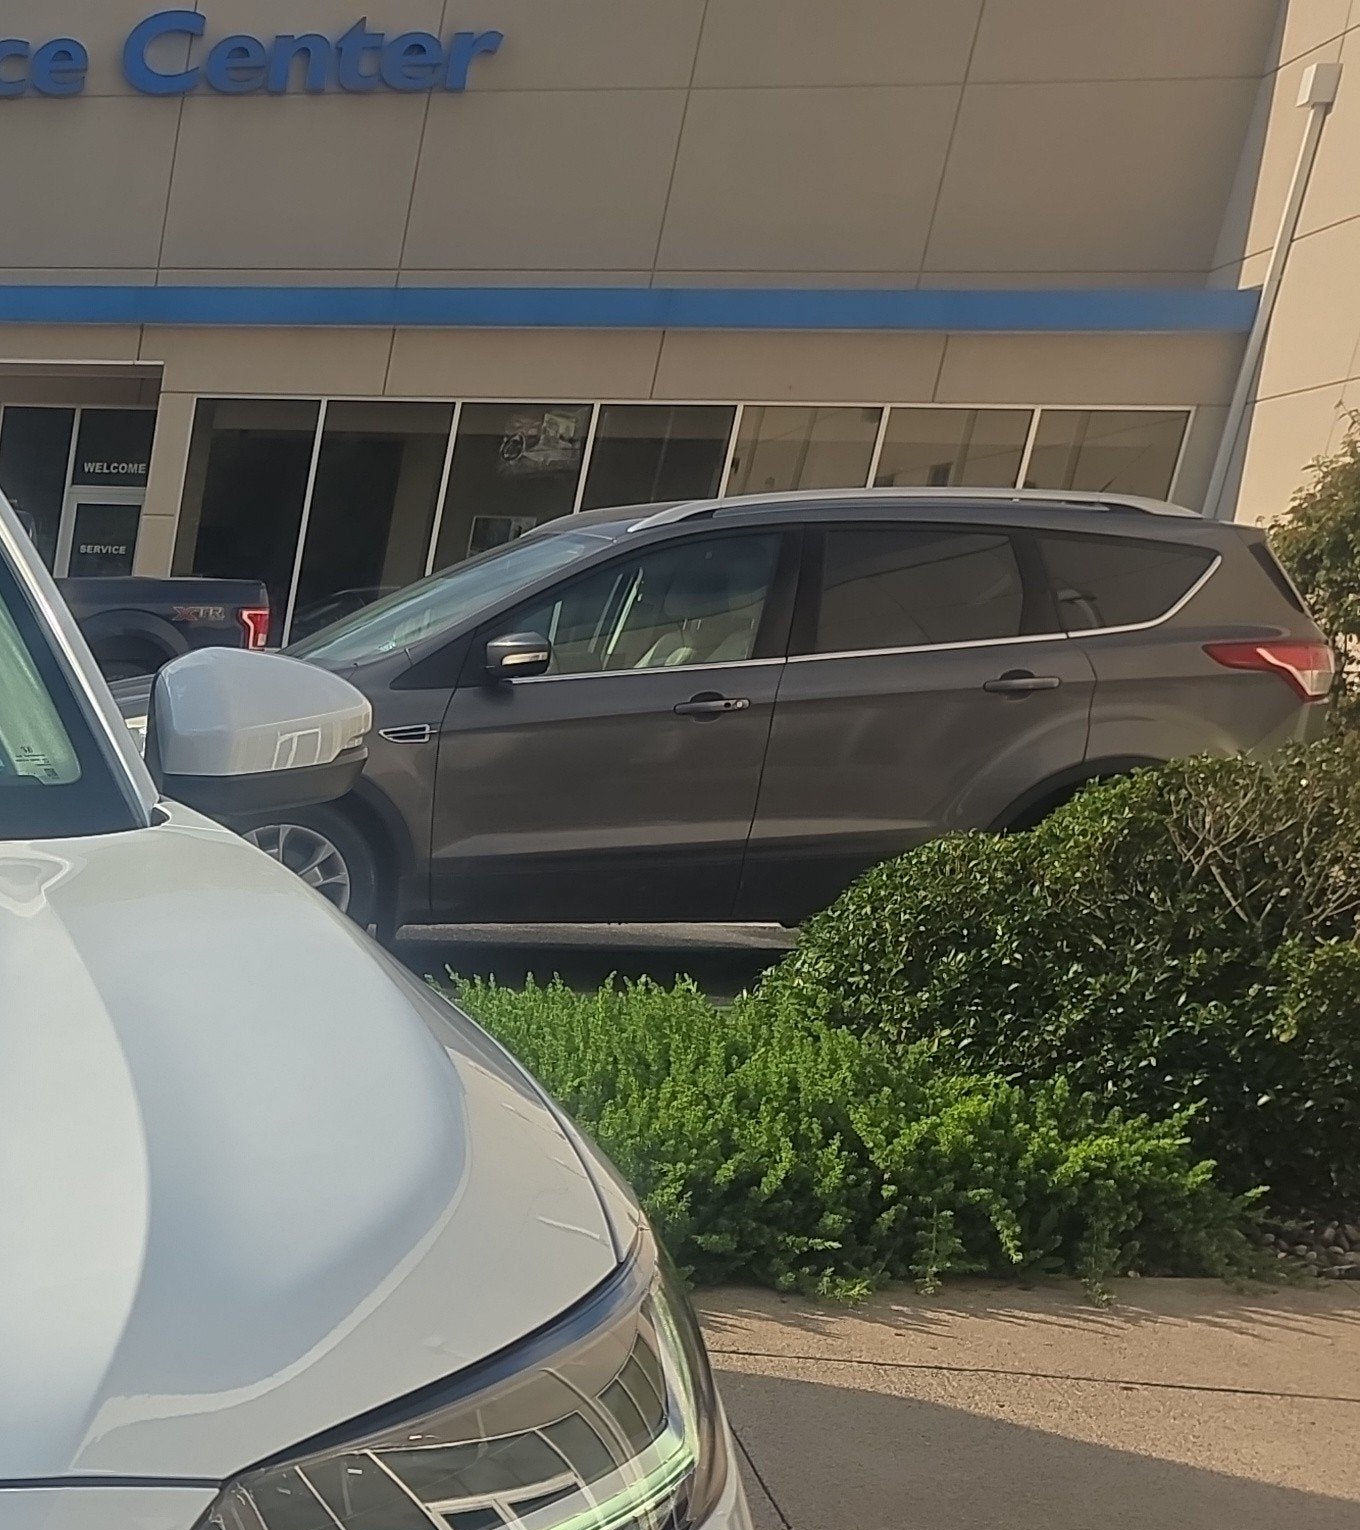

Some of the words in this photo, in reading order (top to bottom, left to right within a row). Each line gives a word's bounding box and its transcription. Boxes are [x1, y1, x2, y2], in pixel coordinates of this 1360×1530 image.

[122, 9, 504, 96] Center
[83, 461, 147, 475] WELCOME
[79, 543, 127, 556] SERVICE
